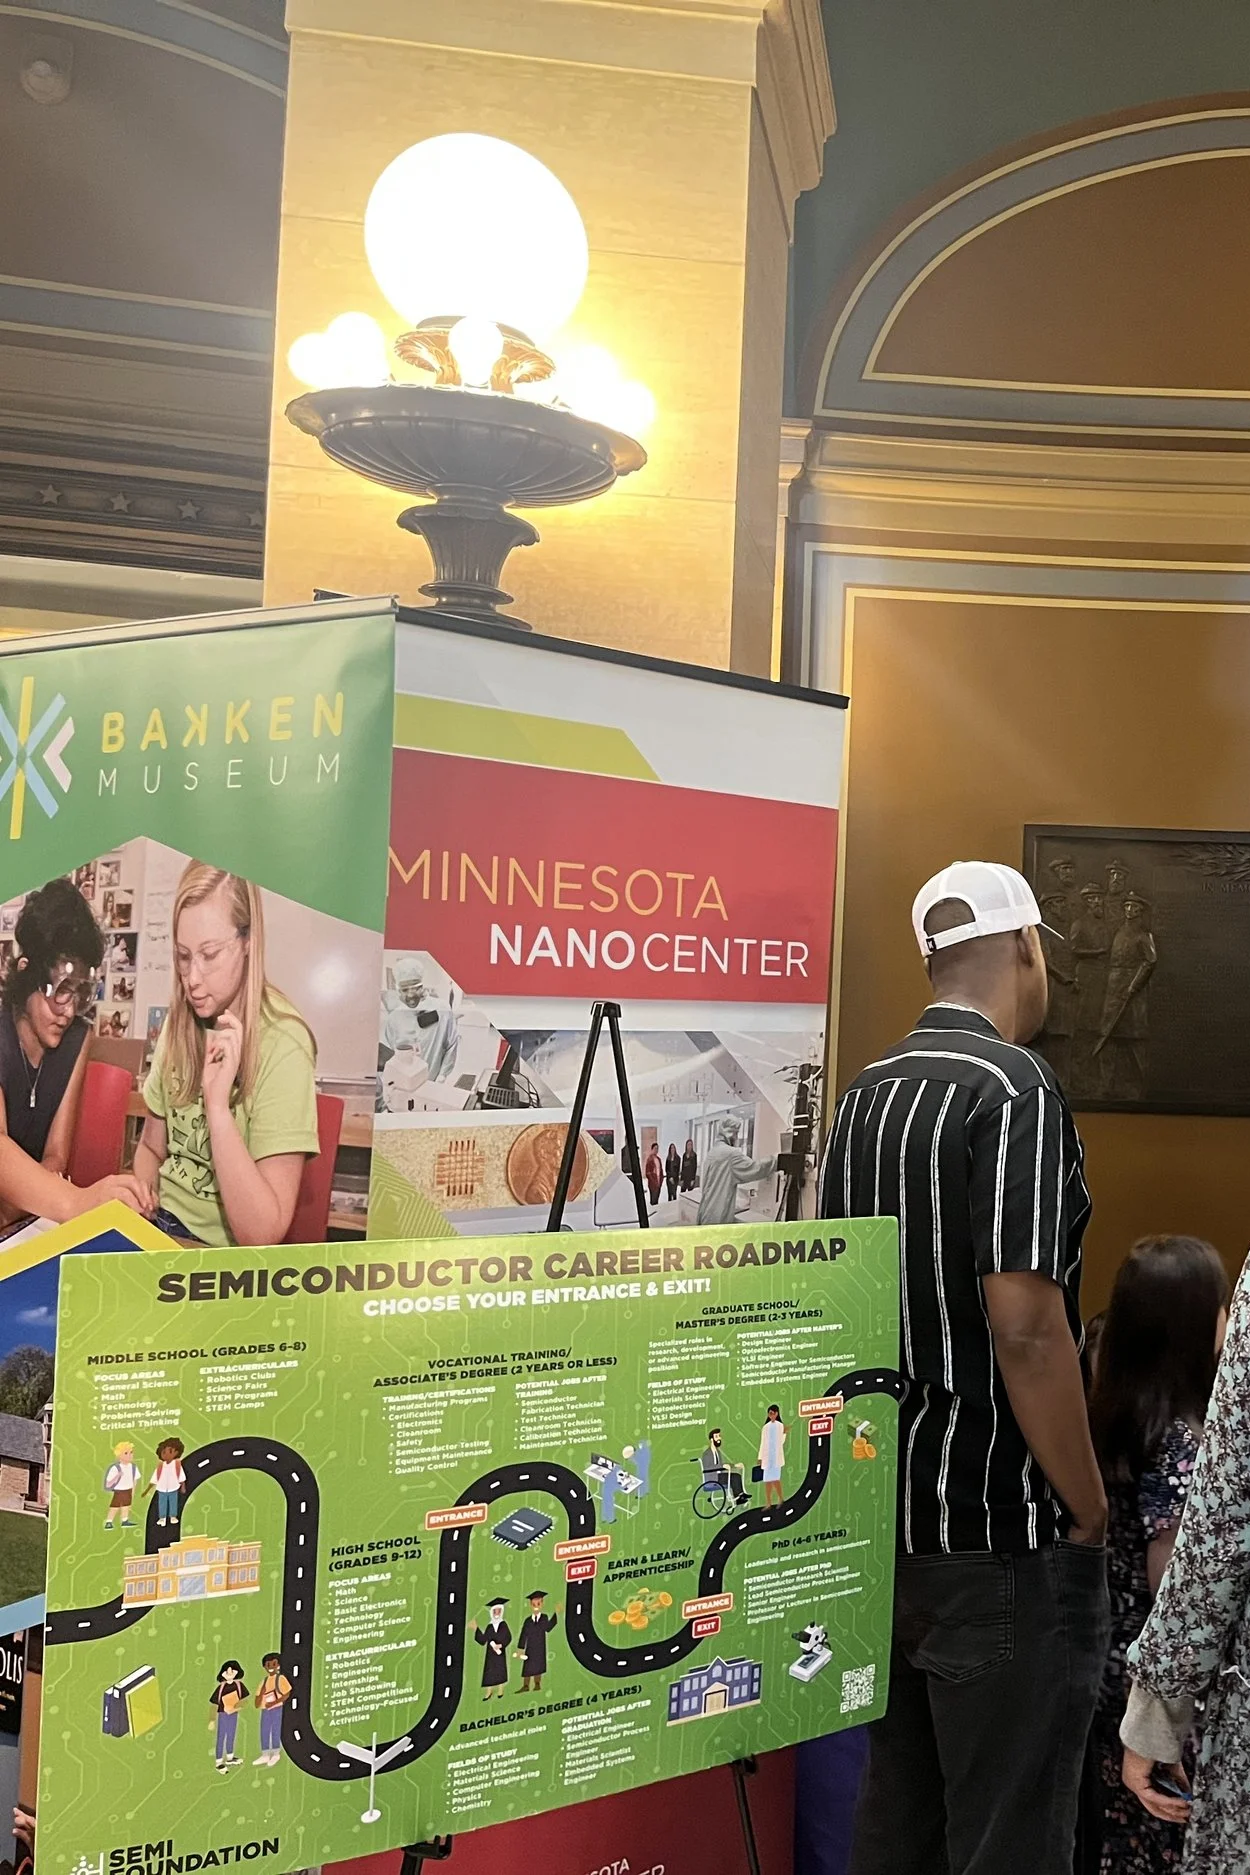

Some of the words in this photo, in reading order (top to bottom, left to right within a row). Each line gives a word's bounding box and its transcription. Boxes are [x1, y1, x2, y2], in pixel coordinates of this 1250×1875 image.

[98, 753, 340, 796] MUSEUM
[388, 847, 729, 921] MINNESOTA
[489, 923, 809, 978] NANOCENTER
[156, 1255, 533, 1303] SEMICONDUCTOR
[542, 1247, 685, 1279] CAREER
[693, 1238, 846, 1270] ROADMAP
[362, 1294, 460, 1317] CHOOSE
[465, 1289, 528, 1309] YOUR
[531, 1282, 641, 1305] ENTRANCE
[645, 1281, 658, 1296] &
[663, 1277, 710, 1295] EXIT!
[702, 1304, 754, 1315] GRADUATE
[757, 1298, 799, 1310] SCHOOL/
[675, 1317, 725, 1329] MASTER'S
[728, 1314, 765, 1325] DEGREE
[768, 1312, 786, 1322] (2-3
[789, 1309, 822, 1320] YEARS)
[87, 1352, 143, 1366] MIDDLE
[148, 1348, 208, 1361] SCHOOL
[212, 1343, 275, 1358] (GRADES
[279, 1340, 306, 1353] 6-8)
[427, 1353, 507, 1369] VOCATIONAL
[510, 1347, 571, 1362] TRAINING/
[199, 1359, 298, 1375] EXTRACURRICULARS
[373, 1371, 456, 1387] ASSOCIATE'S
[460, 1366, 507, 1379] DEGREE
[511, 1365, 522, 1375] (2
[526, 1361, 564, 1372] YEARS
[567, 1359, 582, 1368] OR
[586, 1356, 617, 1367] LESS)
[94, 1373, 128, 1383] FOCUS
[130, 1370, 165, 1380] AREAS
[102, 1382, 139, 1392] General
[143, 1378, 179, 1389] Science
[206, 1373, 247, 1384] Robotics
[250, 1371, 276, 1380] Clubs
[515, 1379, 559, 1390] POTENTIAL
[561, 1377, 580, 1385] JOBS
[582, 1374, 607, 1383] AFTER
[206, 1383, 241, 1393] Science
[245, 1381, 267, 1390] Fairs
[206, 1393, 231, 1402] STEM
[234, 1389, 277, 1402] Programs
[101, 1392, 125, 1401] Math
[388, 1399, 447, 1413] Manufacturing
[450, 1395, 488, 1406] Programs
[521, 1394, 577, 1407] Semiconductor
[100, 1406, 180, 1423] Problem-Solving
[101, 1399, 157, 1413] Technology
[205, 1403, 231, 1412] STEM
[234, 1400, 264, 1411] Camps
[521, 1404, 564, 1415] Fabrication
[566, 1400, 604, 1410] Technician
[802, 1400, 839, 1412] ENTRANCE
[100, 1420, 134, 1431] Critical
[138, 1416, 179, 1428] Thinking
[388, 1409, 443, 1421] Certifications
[396, 1417, 442, 1429] Electronics
[520, 1415, 536, 1423] Test
[669, 1411, 692, 1420] Design
[396, 1426, 441, 1437] Cleanroom
[519, 1430, 561, 1441] Calibration
[563, 1425, 602, 1436] Technician
[520, 1421, 561, 1432] Cleanroom
[562, 1417, 601, 1427] Technician
[812, 1421, 828, 1430] EXIT
[395, 1443, 457, 1456] Semiconductor
[459, 1439, 489, 1449] Testing
[396, 1438, 423, 1448] Safety
[519, 1438, 566, 1450] Maintenance
[568, 1433, 607, 1444] Technician
[395, 1453, 440, 1466] Equipment
[442, 1447, 492, 1459] Maintenance
[395, 1464, 424, 1475] Quality
[427, 1460, 458, 1471] Control
[429, 1509, 482, 1524] ENTRANCE
[331, 1543, 363, 1557] HIGH
[367, 1535, 420, 1551] SCHOOL
[772, 1538, 789, 1549] PhD
[792, 1535, 811, 1546] (4-6
[814, 1528, 846, 1542] YEARS)
[558, 1540, 606, 1555] ENTRANCE
[329, 1553, 387, 1571] (GRADES
[391, 1548, 421, 1562] 9-12)
[608, 1556, 638, 1570] EARN
[640, 1555, 647, 1564] &
[650, 1546, 691, 1563] LEARN/
[570, 1564, 591, 1575] EXIT
[603, 1559, 694, 1584] APPRENTICESHIP
[328, 1577, 358, 1588] FOCUS
[361, 1572, 391, 1583] AREAS
[335, 1586, 356, 1596] Math
[334, 1605, 356, 1616] Basic
[359, 1597, 406, 1611] Electronics
[335, 1594, 367, 1606] Science
[685, 1598, 729, 1613] ENTRANCE
[333, 1620, 375, 1635] Computer
[378, 1614, 410, 1627] Science
[334, 1610, 383, 1626] Technology
[696, 1621, 715, 1632] EXIT
[332, 1628, 384, 1645] Engineering
[325, 1638, 416, 1662] EXTRACURRICULARS
[332, 1656, 370, 1670] Robotics
[331, 1663, 383, 1681] Engineering
[330, 1689, 346, 1698] Job
[349, 1679, 396, 1696] Shadowing
[331, 1673, 378, 1690] Internships
[330, 1696, 354, 1708] STEM
[357, 1685, 413, 1703] Competitions
[330, 1692, 418, 1719] Technology-Focused
[459, 1708, 534, 1732] BACHELOR'S
[538, 1697, 582, 1715] DEGREE
[586, 1694, 597, 1705] (4
[601, 1684, 641, 1701] YEARS)
[562, 1709, 604, 1725] POTENTIAL
[606, 1705, 625, 1715] JOBS
[627, 1699, 651, 1710] AFTER
[329, 1712, 370, 1727] Activities
[448, 1736, 488, 1752] Advanced
[490, 1728, 526, 1742] technical
[527, 1723, 546, 1734] roles
[453, 1762, 490, 1778] Electrical
[492, 1752, 538, 1770] Engineering
[452, 1780, 491, 1797] Computer
[494, 1768, 540, 1787] Engineering
[453, 1772, 488, 1787] Materials
[491, 1764, 520, 1777] Science
[451, 1797, 491, 1815] Chemistry
[452, 1791, 481, 1806] Physics
[108, 1839, 174, 1868] SEMI
[109, 1837, 279, 1875] FOUNDATION
